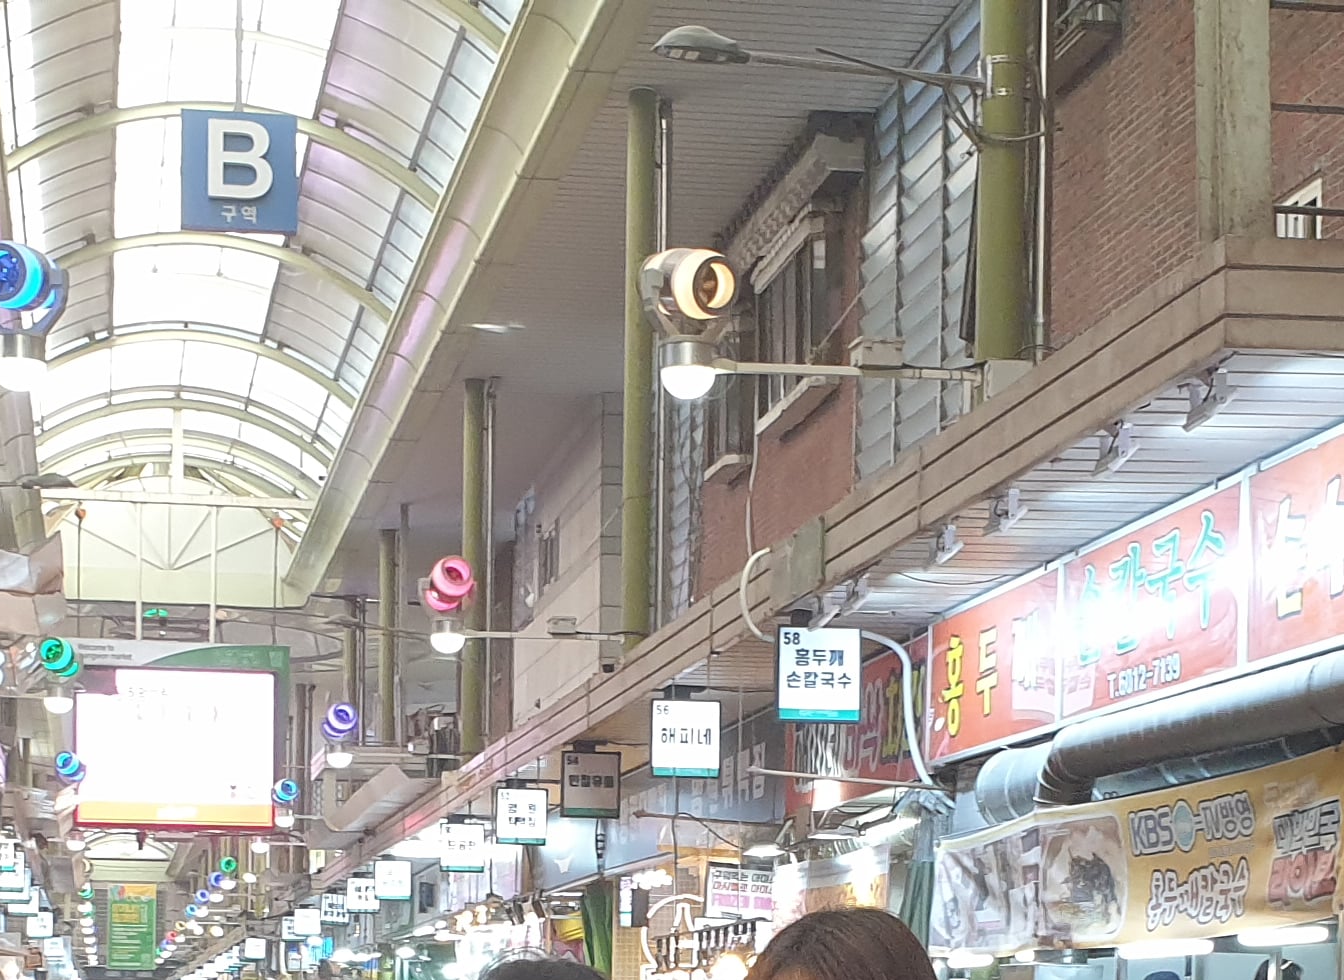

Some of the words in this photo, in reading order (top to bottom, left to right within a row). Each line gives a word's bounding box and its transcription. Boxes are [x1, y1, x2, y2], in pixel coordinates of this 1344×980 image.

[207, 118, 274, 199] B
[220, 205, 258, 224] 구역
[783, 632, 802, 646] 58
[794, 648, 845, 667] 홍두깨
[786, 671, 853, 689] 손칼국수
[656, 705, 670, 716] 56
[660, 727, 712, 746] 해피네
[1129, 808, 1176, 857] KBS
